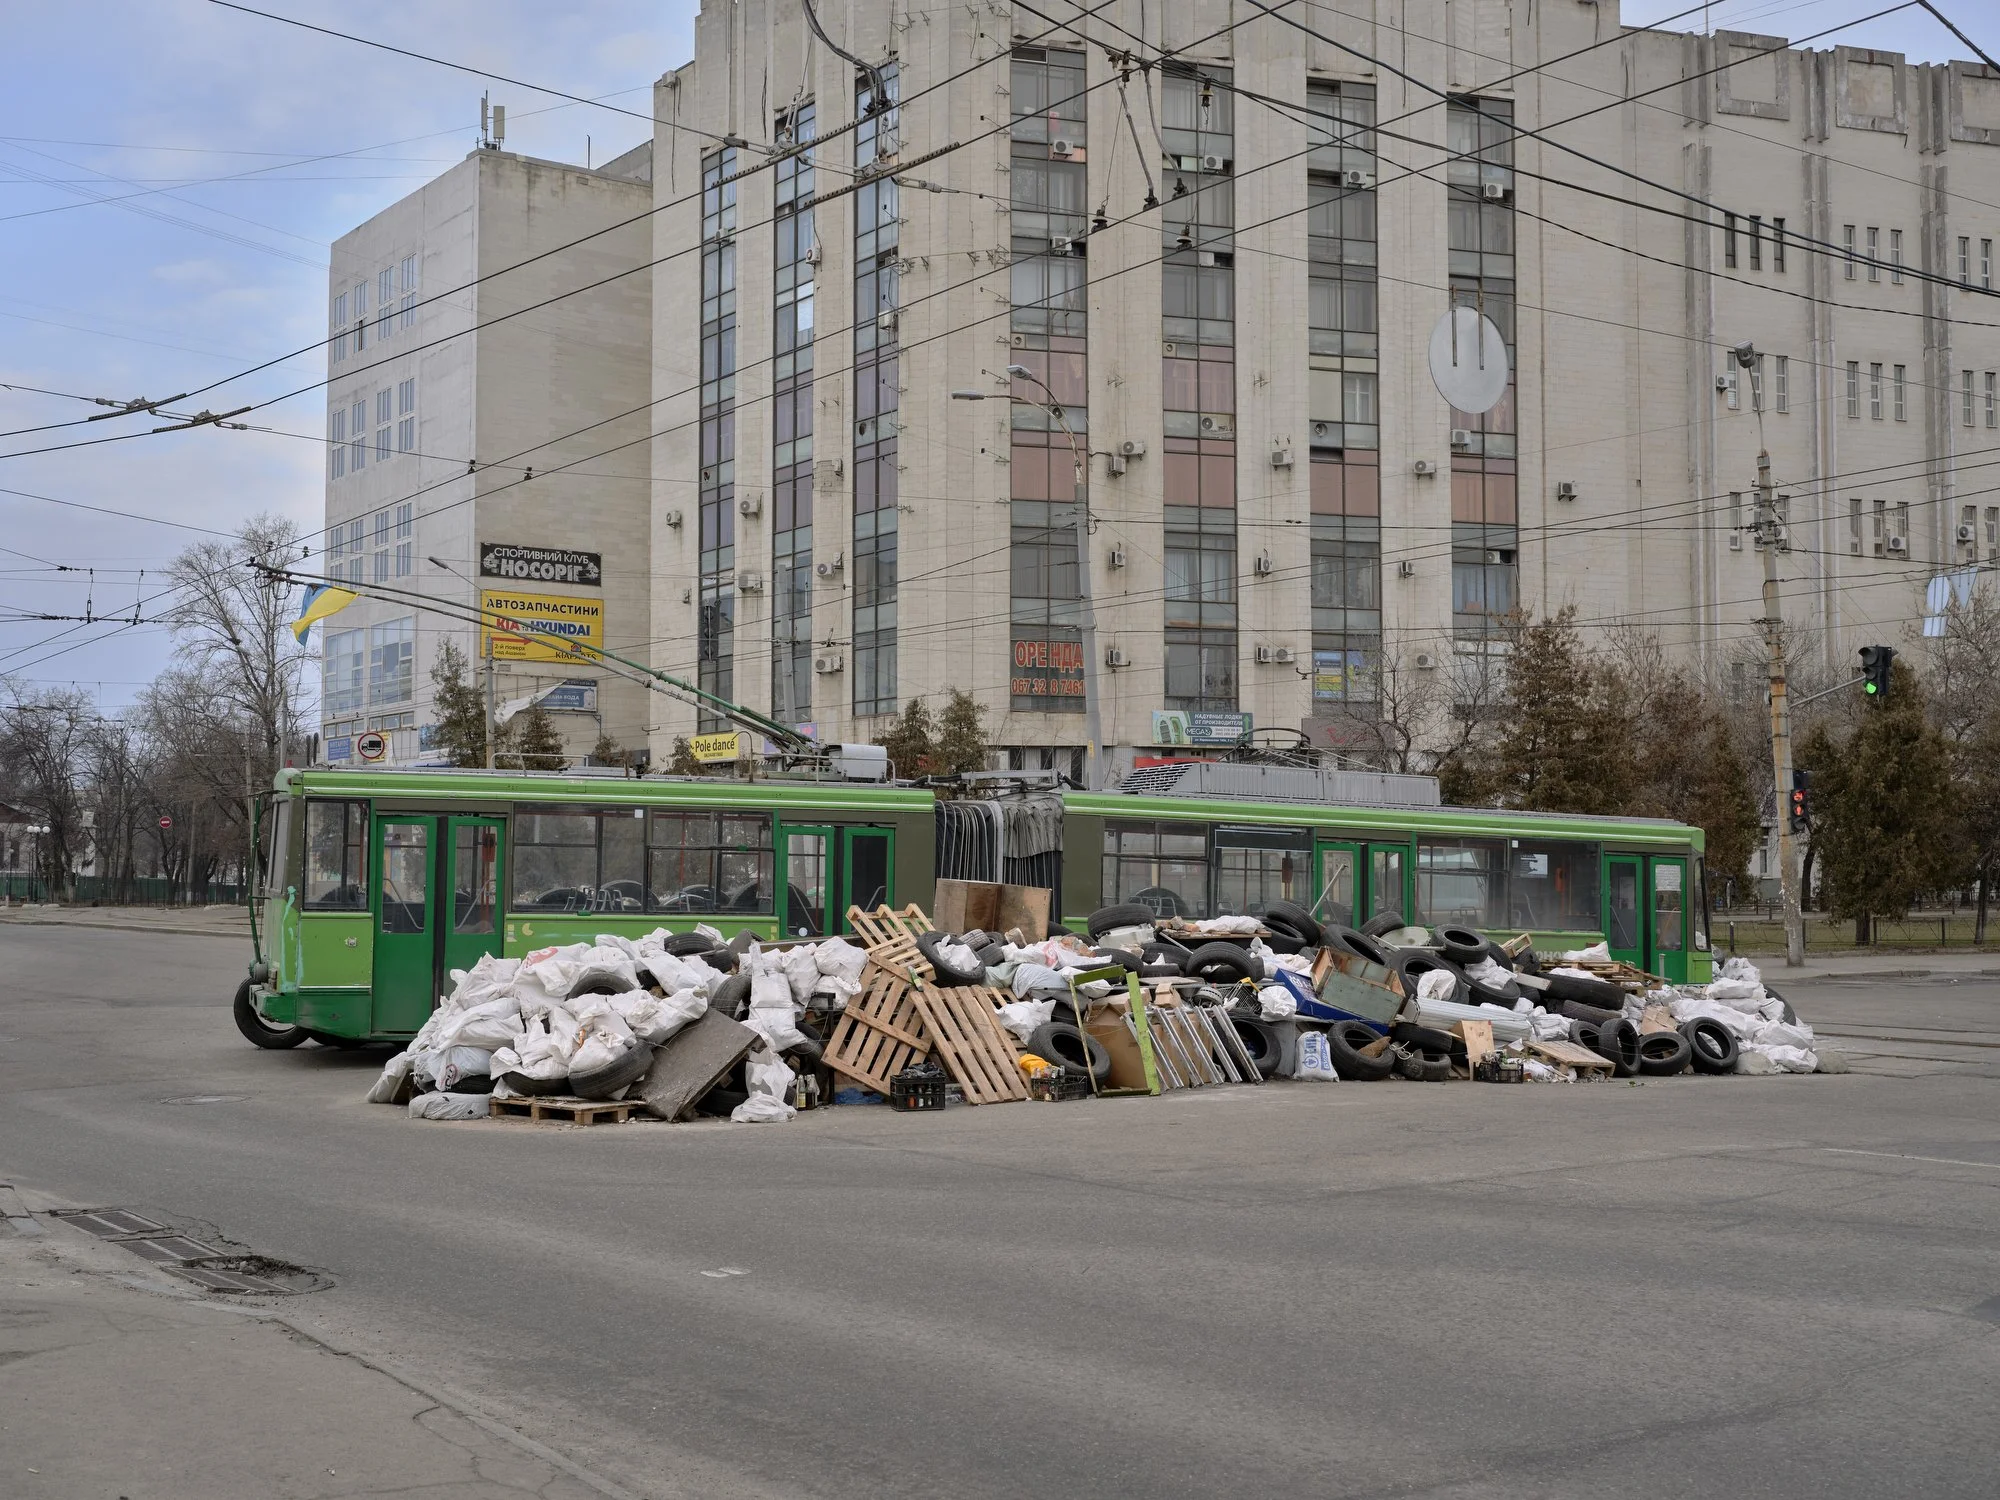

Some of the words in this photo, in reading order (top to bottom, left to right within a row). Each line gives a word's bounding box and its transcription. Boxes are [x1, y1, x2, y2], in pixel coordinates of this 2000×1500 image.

[494, 547, 562, 562] СПОРТИВНИЙ
[564, 554, 589, 564] КЛУБ
[486, 598, 599, 616] АВТОЗАПЧАСТИНИ
[496, 618, 520, 631] KIA
[530, 620, 591, 636] HYUNDAI
[695, 740, 711, 752] Pole
[713, 739, 735, 751] dance
